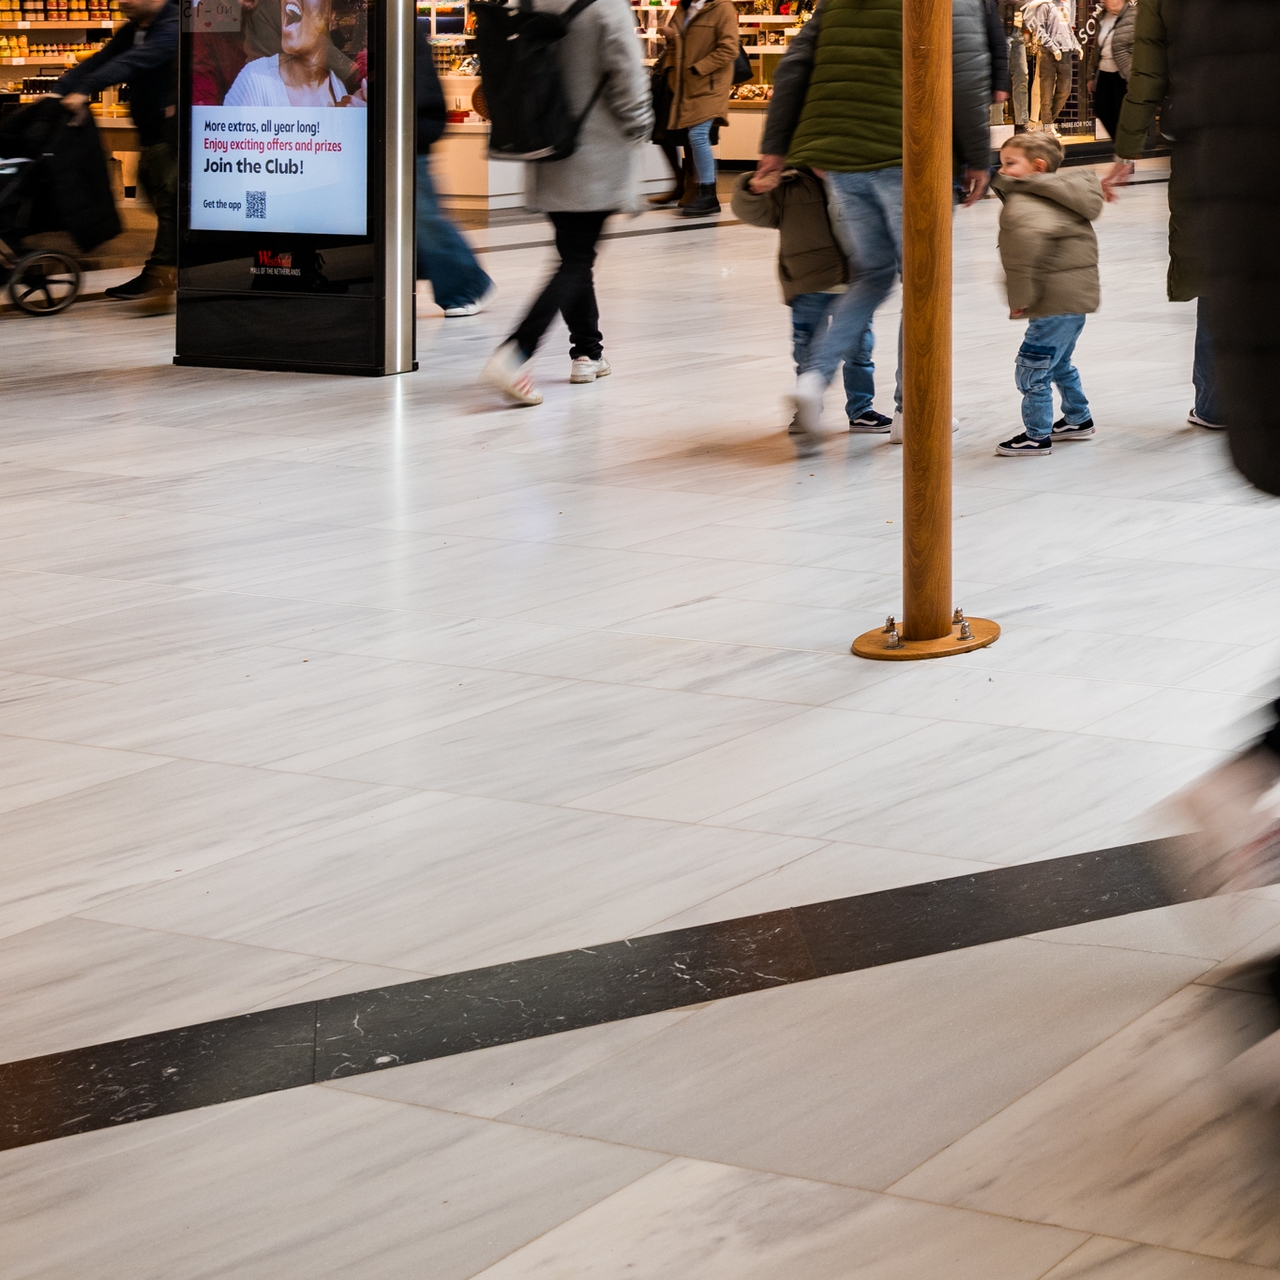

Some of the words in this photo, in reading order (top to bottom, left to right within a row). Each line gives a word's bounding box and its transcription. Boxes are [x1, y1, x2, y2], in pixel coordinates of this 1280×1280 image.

[204, 120, 226, 132] More
[228, 121, 258, 134] extras,
[261, 120, 272, 132] all
[273, 123, 294, 135] year
[297, 120, 320, 136] long!
[203, 138, 228, 153] Enjoy
[230, 138, 264, 153] exciting
[266, 138, 293, 151] offers
[295, 138, 313, 152] and
[314, 139, 342, 154] prizes
[203, 157, 232, 173] Join
[236, 158, 262, 174] the
[265, 158, 304, 174] Club!
[203, 199, 215, 209] Get
[216, 199, 227, 209] the
[228, 201, 242, 211] app
[258, 250, 293, 267] Westfield
[274, 267, 301, 276] NETHERLANDS
